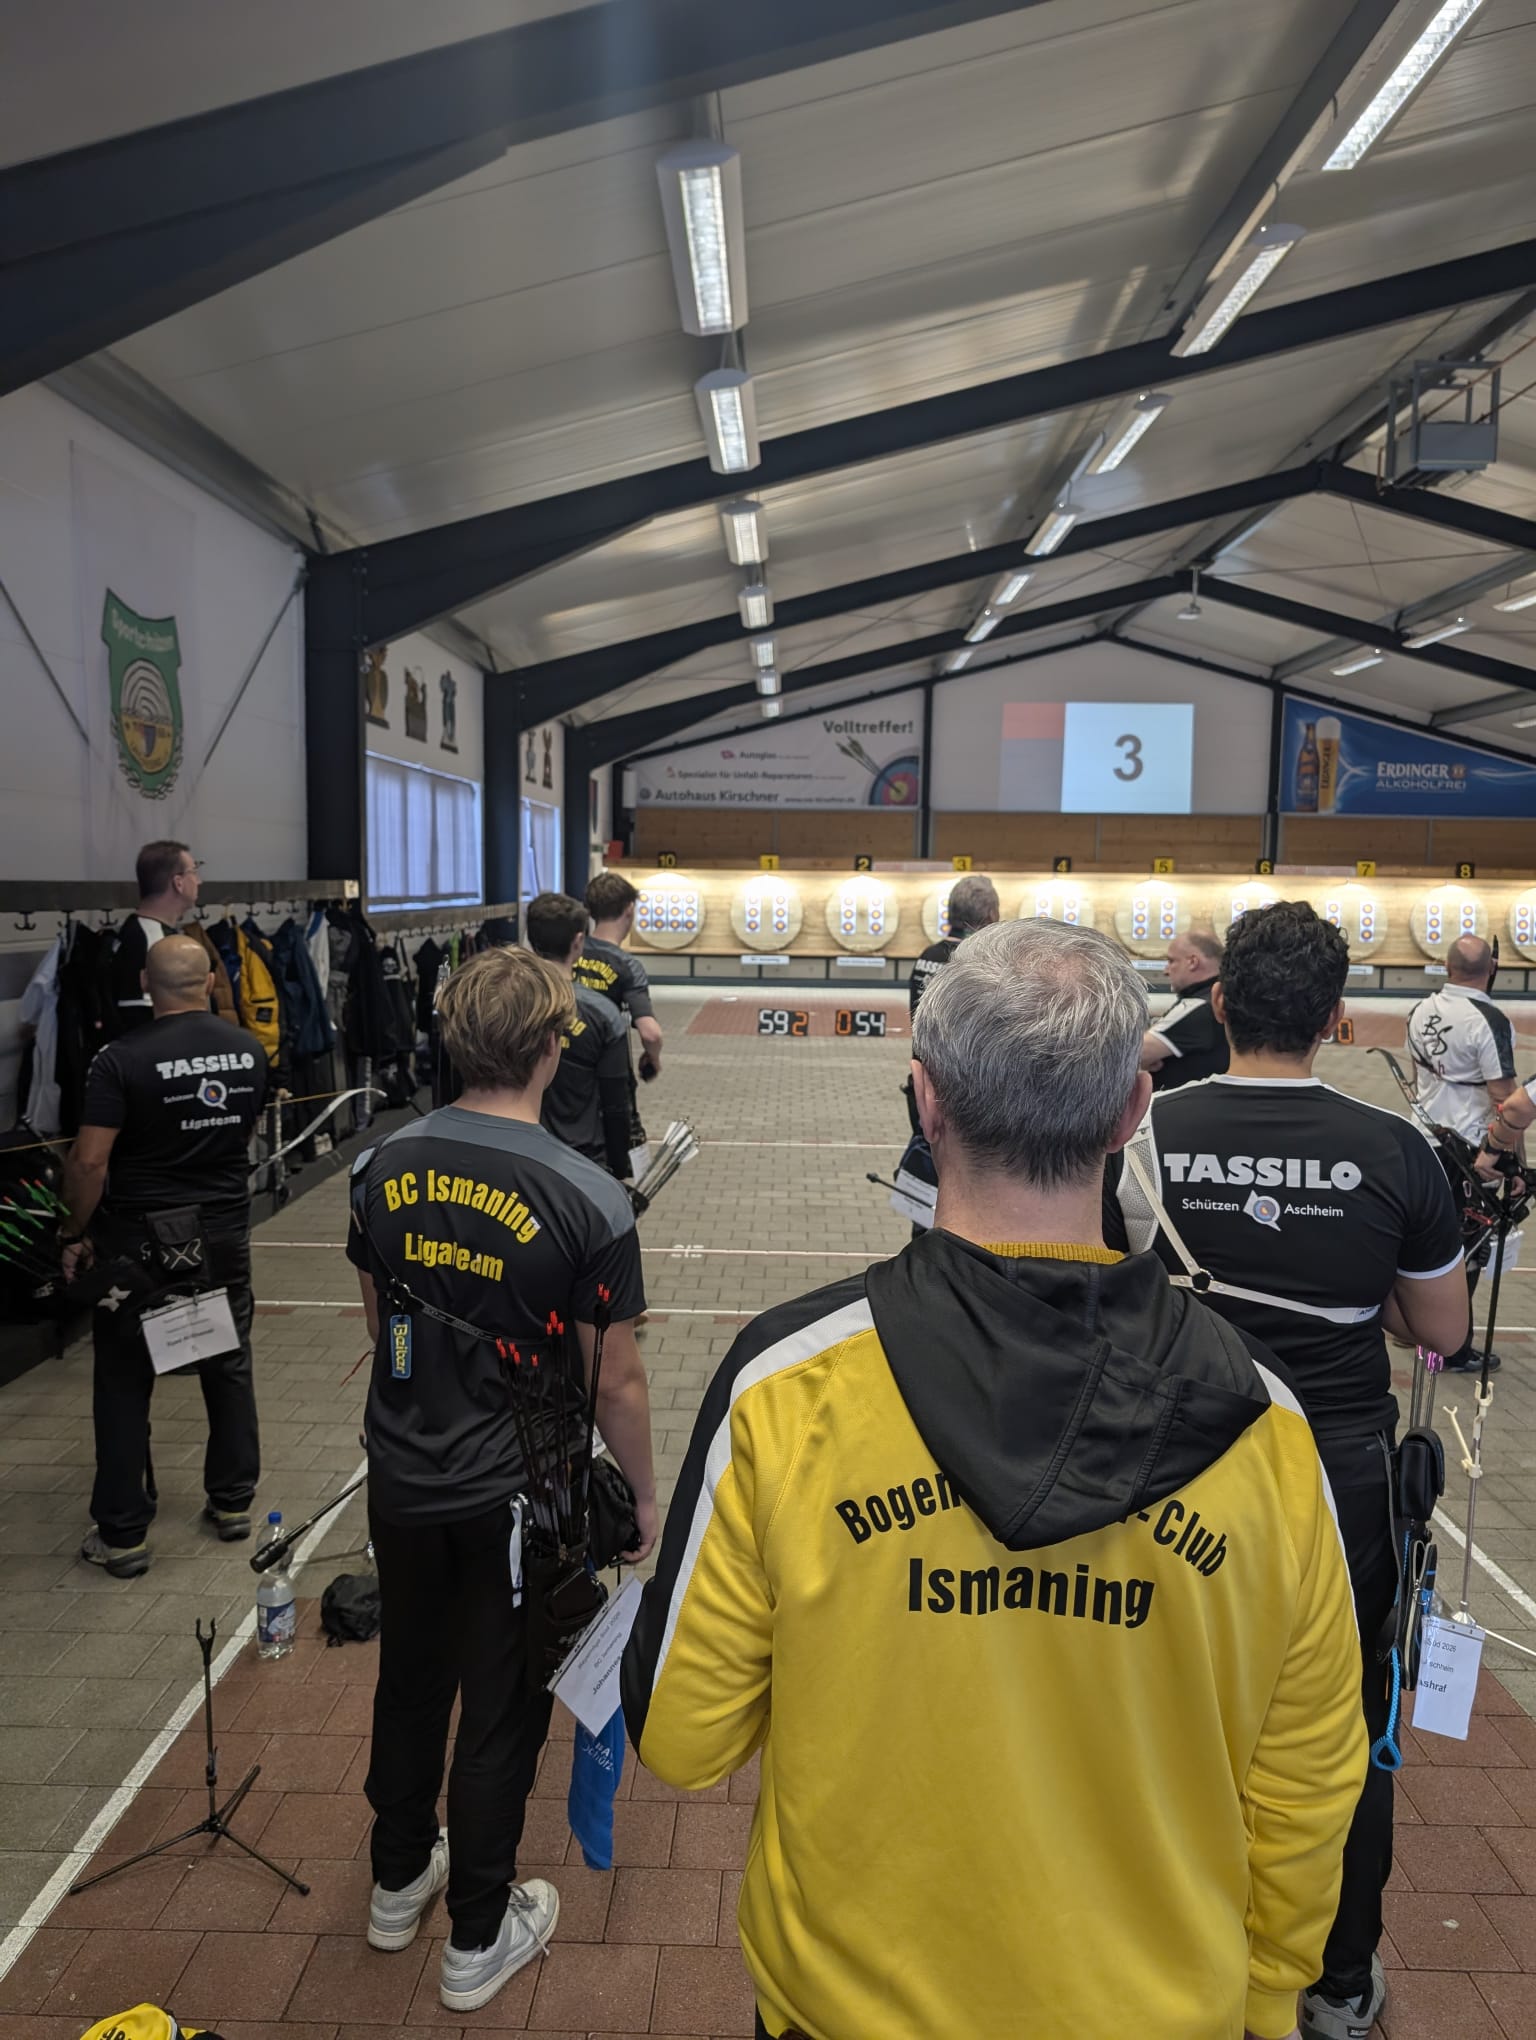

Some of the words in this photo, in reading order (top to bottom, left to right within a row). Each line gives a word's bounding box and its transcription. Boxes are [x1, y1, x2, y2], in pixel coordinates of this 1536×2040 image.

[823, 720, 913, 734] Volltreffer!
[740, 752, 776, 761] Autoglas
[1113, 734, 1144, 781] 3
[678, 771, 717, 779] Spezialist
[1377, 761, 1449, 778] ERDINGER
[1376, 779, 1466, 790] ALKOHOLFREI
[655, 789, 717, 801] Autohaus
[720, 789, 779, 801] Kirschner
[659, 854, 675, 868] 10
[767, 858, 774, 870] 1
[858, 857, 869, 871] 2
[957, 858, 967, 871] 3
[1057, 860, 1067, 872] 4
[1159, 861, 1168, 872] 5
[1260, 861, 1270, 874] 6
[1361, 864, 1371, 877] 7
[1460, 864, 1471, 878] 8
[759, 1009, 789, 1034] 59
[792, 1011, 808, 1036] 2
[836, 1010, 851, 1036] 0
[855, 1011, 885, 1036] 54
[156, 1052, 255, 1080] TASSILO
[181, 1115, 241, 1131] Ligateam
[1164, 1153, 1362, 1191] TASSILO
[384, 1172, 418, 1212] BC
[427, 1169, 541, 1244] Ismaning
[1182, 1197, 1240, 1212] Schützen
[1284, 1203, 1344, 1218] Aschheim
[405, 1232, 504, 1282] Ligateam
[908, 1558, 1155, 1628] Ismaning
